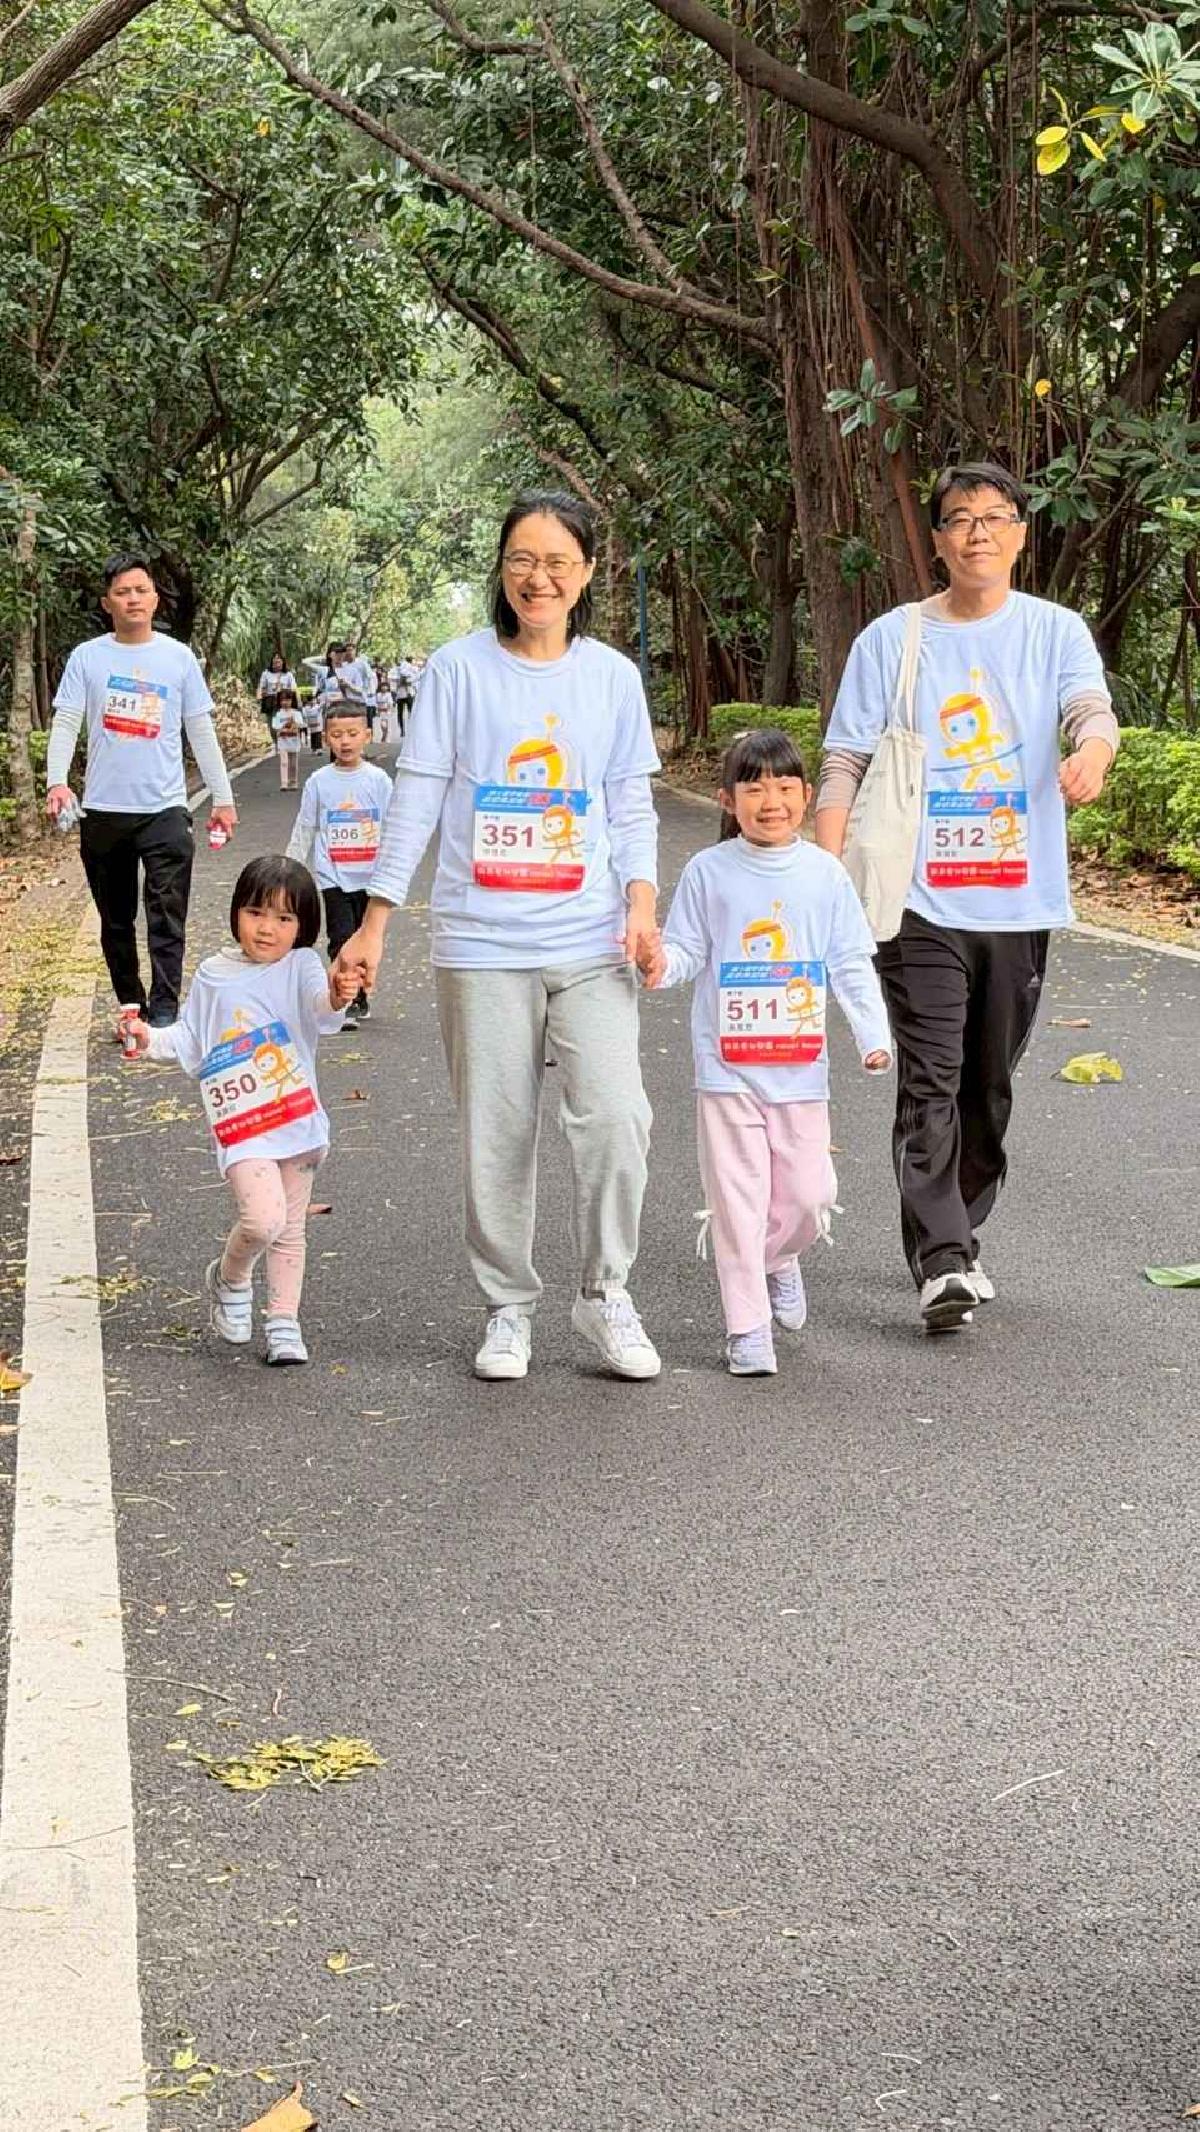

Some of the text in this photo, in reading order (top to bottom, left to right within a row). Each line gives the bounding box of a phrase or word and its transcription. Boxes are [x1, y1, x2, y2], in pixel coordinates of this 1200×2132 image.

[109, 695, 136, 712] 341
[331, 828, 359, 840] 306
[482, 823, 534, 848] 351
[935, 826, 986, 848] 512
[727, 998, 778, 1020] 511
[209, 1073, 257, 1108] 350
